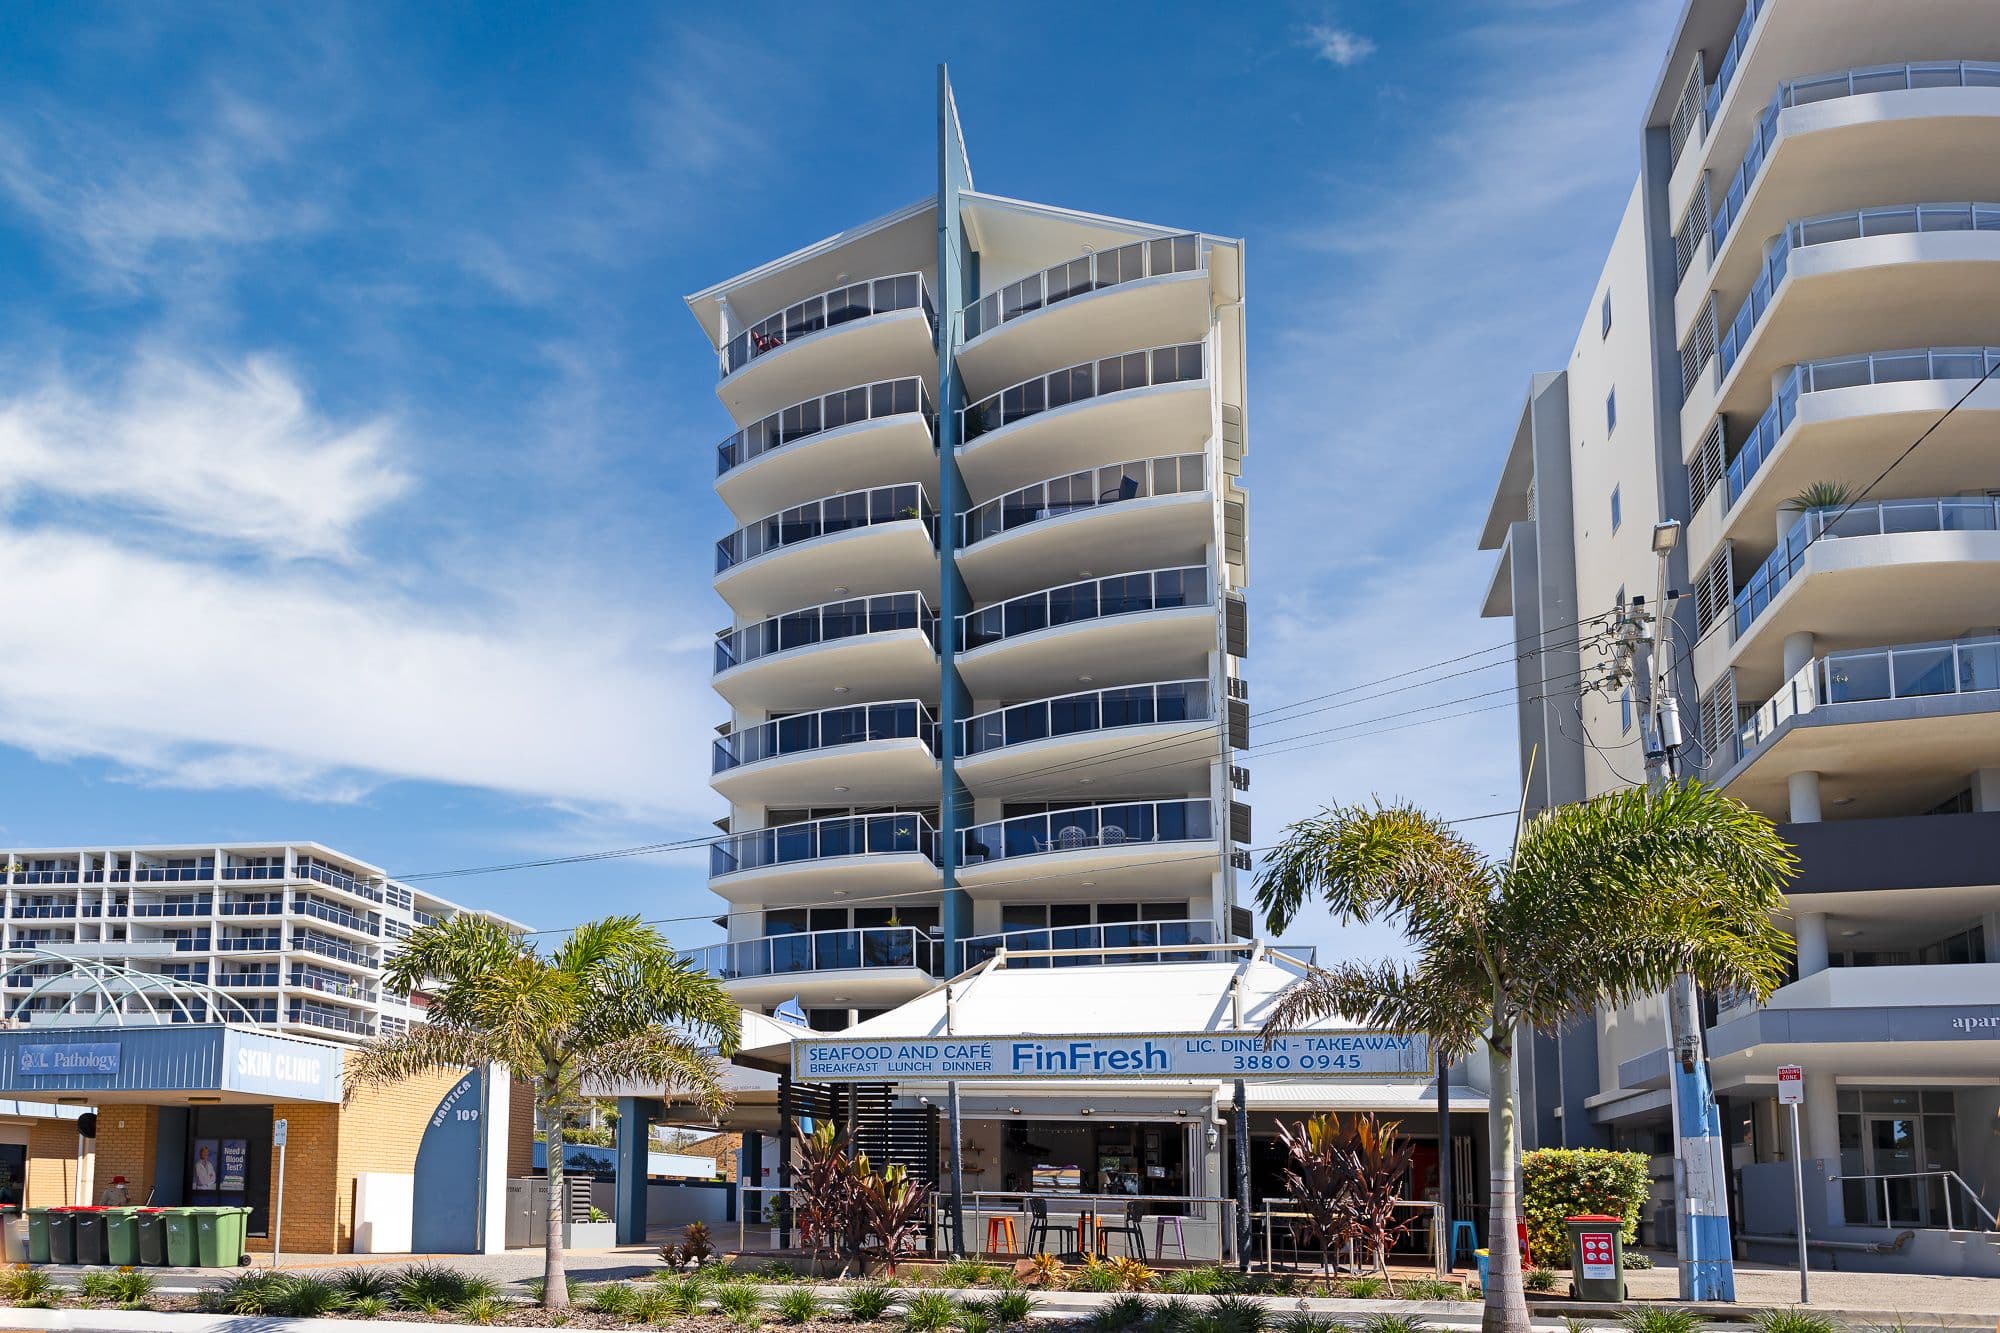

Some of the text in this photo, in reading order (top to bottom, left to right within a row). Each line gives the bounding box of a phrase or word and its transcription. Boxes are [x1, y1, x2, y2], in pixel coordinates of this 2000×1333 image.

[809, 1042, 992, 1061] SEAFOOD AND CAFÉ
[1186, 1039, 1216, 1053] LIC.
[1221, 1039, 1263, 1052] DINE
[1305, 1037, 1410, 1051] TAKEAWAY
[1012, 1041, 1170, 1071] FinFresh
[1233, 1054, 1361, 1070] 3880 0945
[239, 1047, 320, 1084] SKIN CLINIC
[810, 1061, 992, 1073] BREAKFAST LUNCH DINNER
[433, 1081, 471, 1127] NAUTICA
[456, 1109, 479, 1121] 109
[224, 1147, 240, 1155] Need
[225, 1155, 244, 1163] Blood
[226, 1163, 243, 1171] Test?
